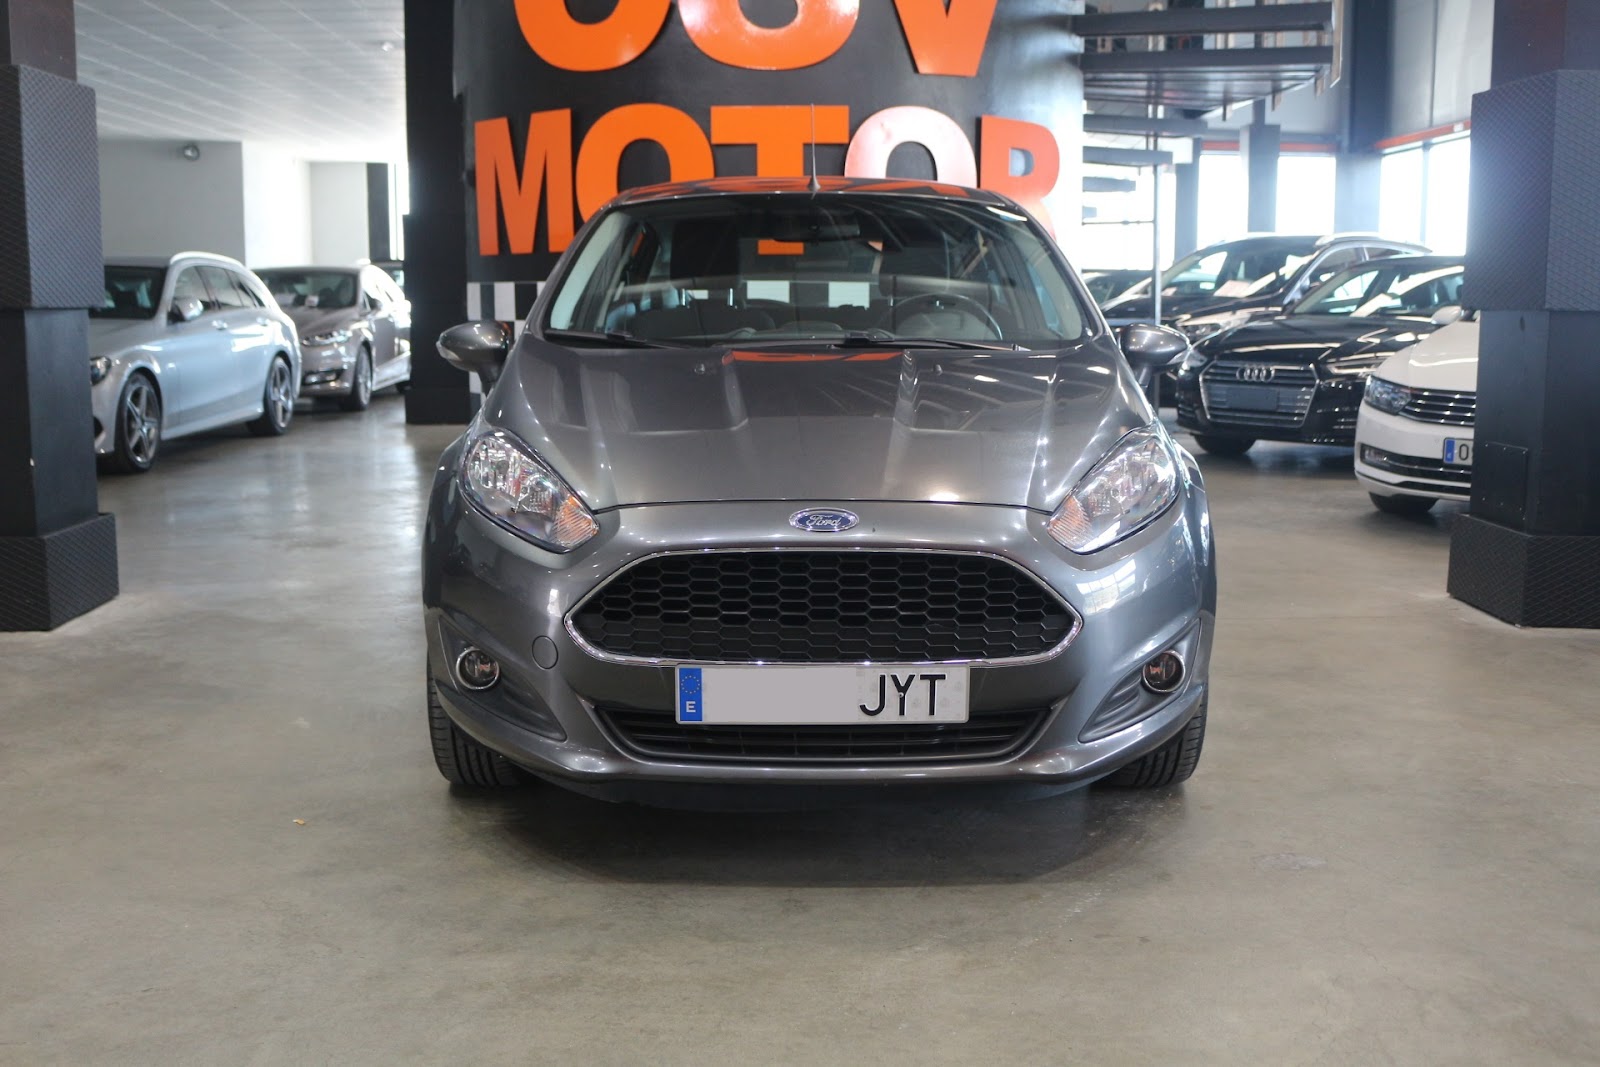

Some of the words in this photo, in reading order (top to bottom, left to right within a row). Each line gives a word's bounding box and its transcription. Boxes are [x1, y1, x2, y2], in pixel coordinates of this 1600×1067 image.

[474, 103, 1060, 255] MOTOR
[805, 514, 841, 527] Ford
[686, 701, 696, 712] E
[859, 674, 946, 716] JYT
